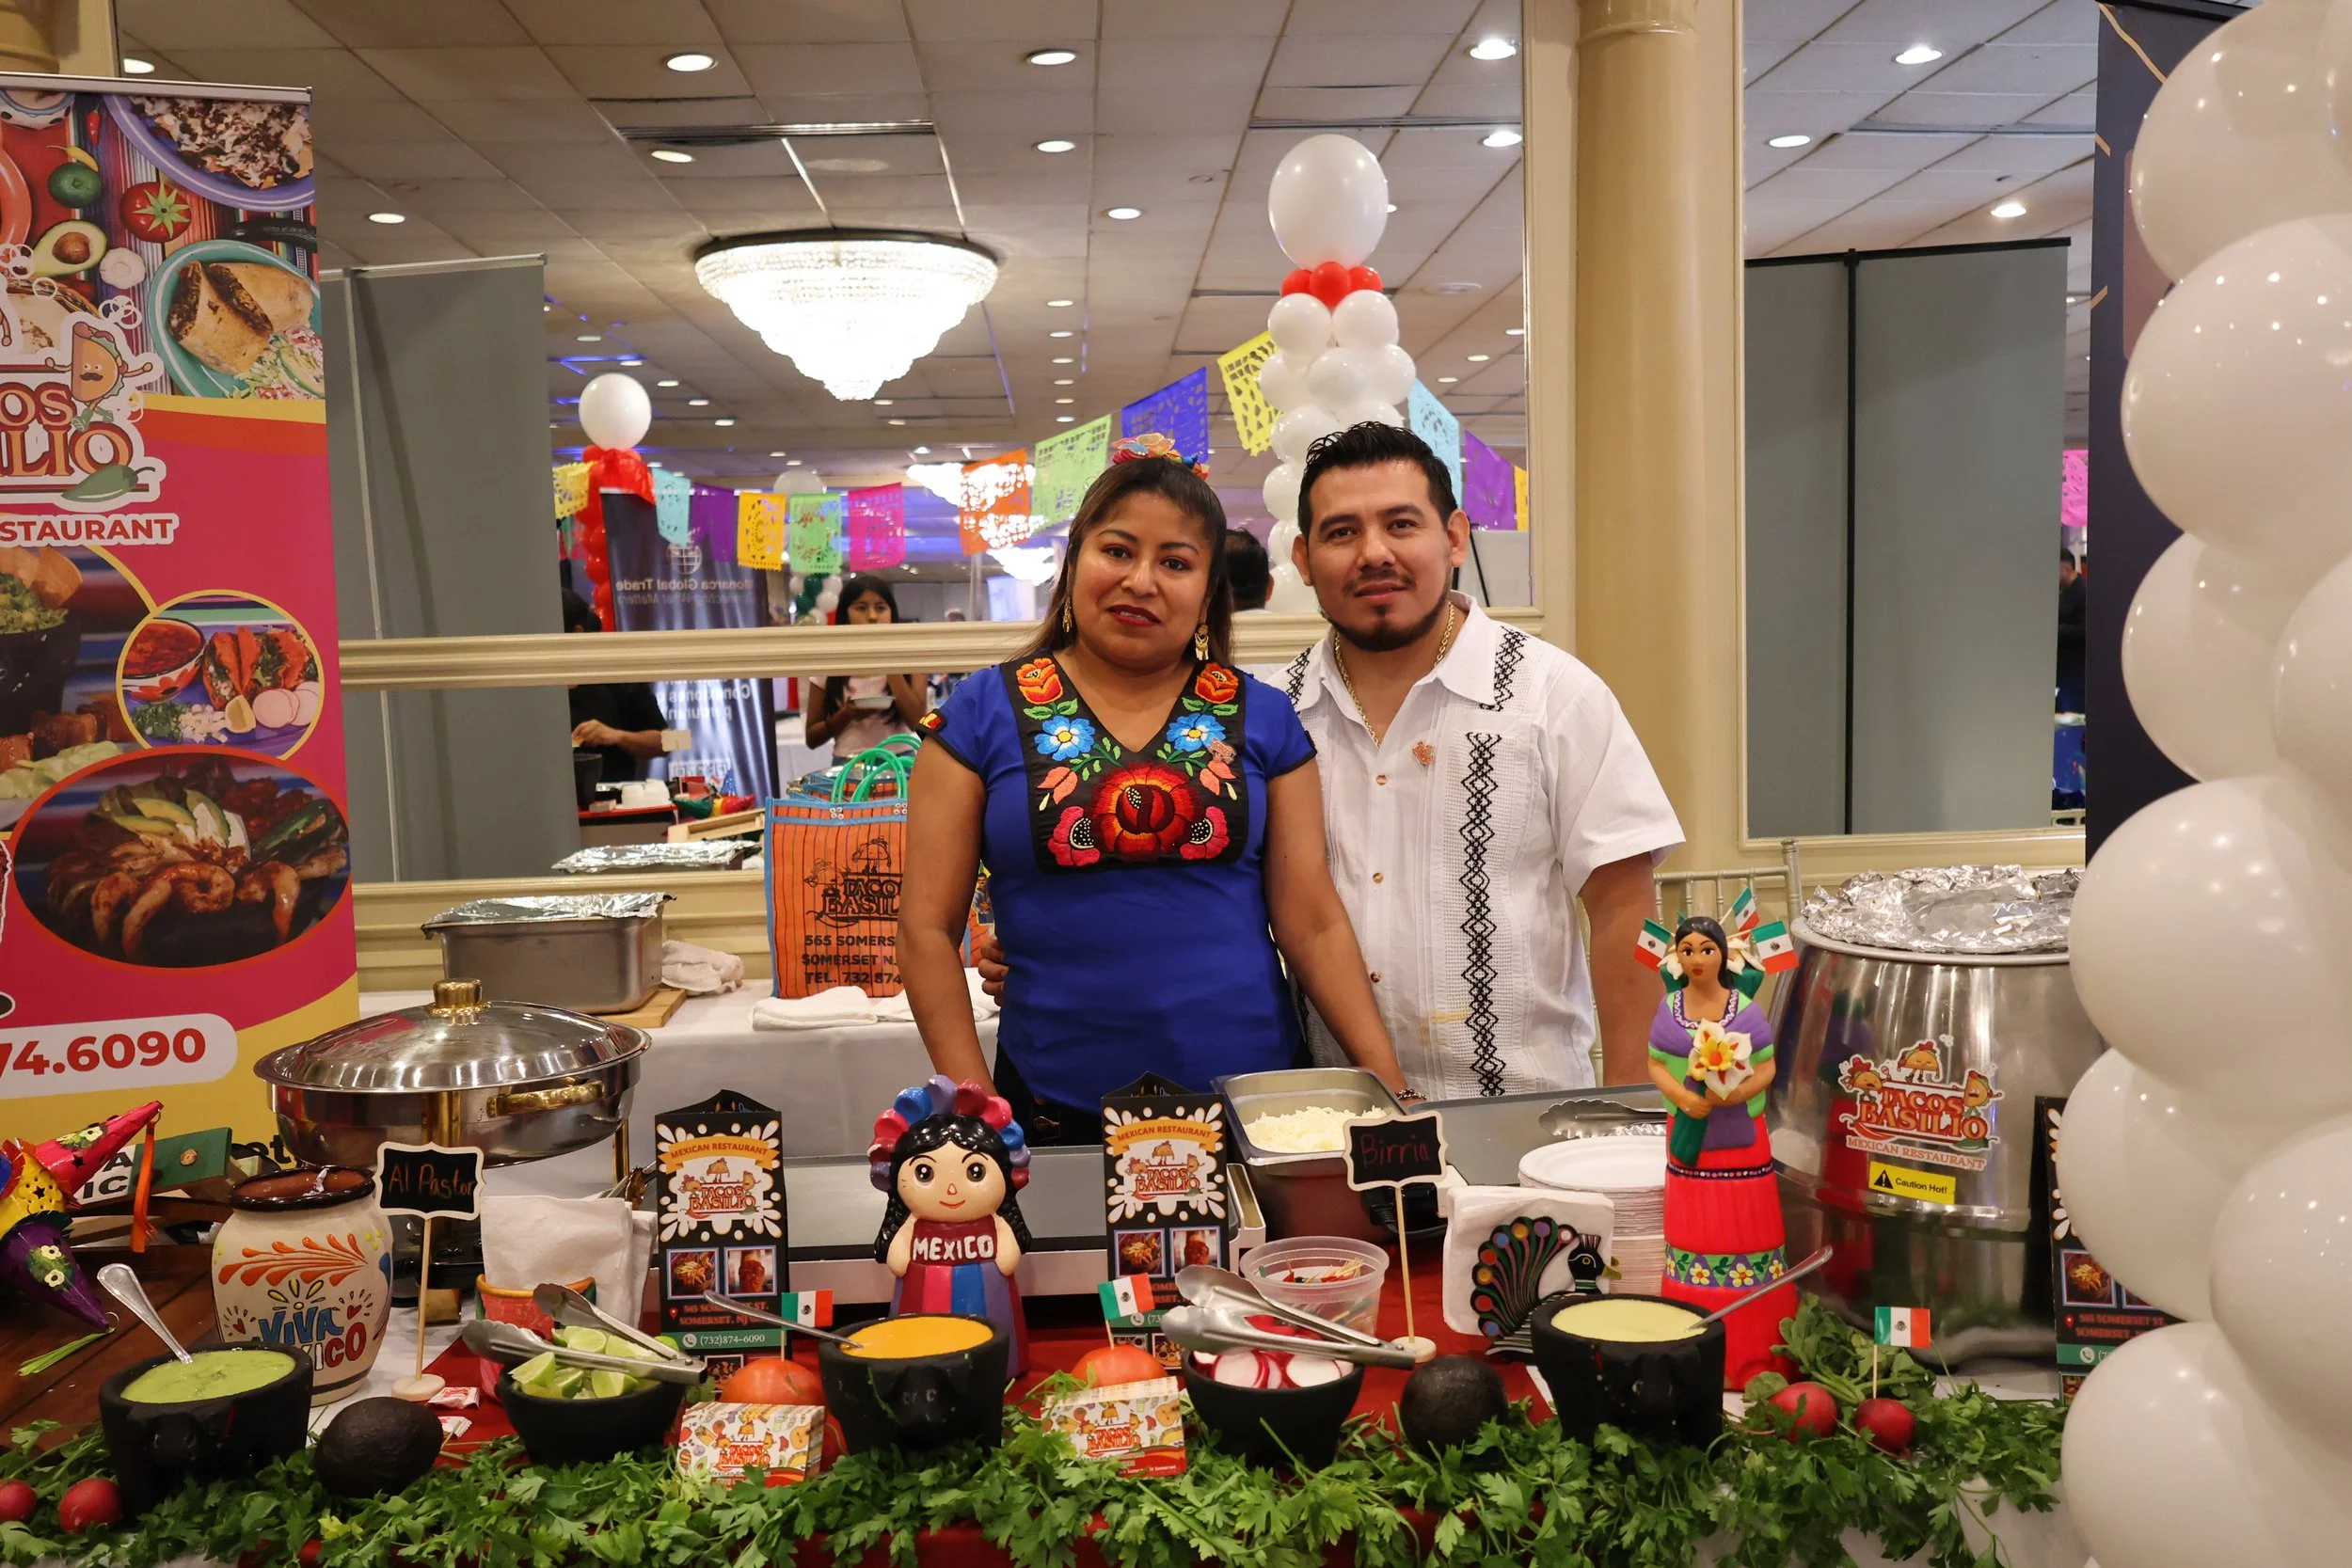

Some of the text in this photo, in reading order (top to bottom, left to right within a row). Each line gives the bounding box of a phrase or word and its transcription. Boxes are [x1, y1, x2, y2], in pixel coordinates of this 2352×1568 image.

[843, 878, 902, 898] TACO
[804, 935, 896, 947] 565 SOMERS
[802, 954, 878, 966] SOMERSET
[805, 972, 903, 984] TEL. 732 874
[1880, 1087, 1964, 1117] TACOS
[1857, 1101, 1988, 1140] BASILIO
[1117, 1126, 1212, 1142] MEXICAN RESTAURANT
[670, 1142, 768, 1159] MEXICAN RESTAURANT
[1360, 1132, 1431, 1169] Birria
[1849, 1136, 1985, 1170] MEXICAN RESTAURANT
[389, 1163, 477, 1199] Al Pastor
[1147, 1168, 1188, 1180] TACOS
[701, 1186, 745, 1199] TACOS
[1136, 1178, 1200, 1193] BASILIO
[1895, 1178, 1947, 1195] Caution Hot!
[689, 1195, 756, 1211] BASILIO
[913, 1235, 994, 1260] MEXICO
[259, 1307, 344, 1345] VIVA
[1096, 1427, 1131, 1439] TACOS
[728, 1444, 764, 1455] TACOS
[1088, 1435, 1141, 1449] BASILIO
[719, 1453, 771, 1465] BASILIO
